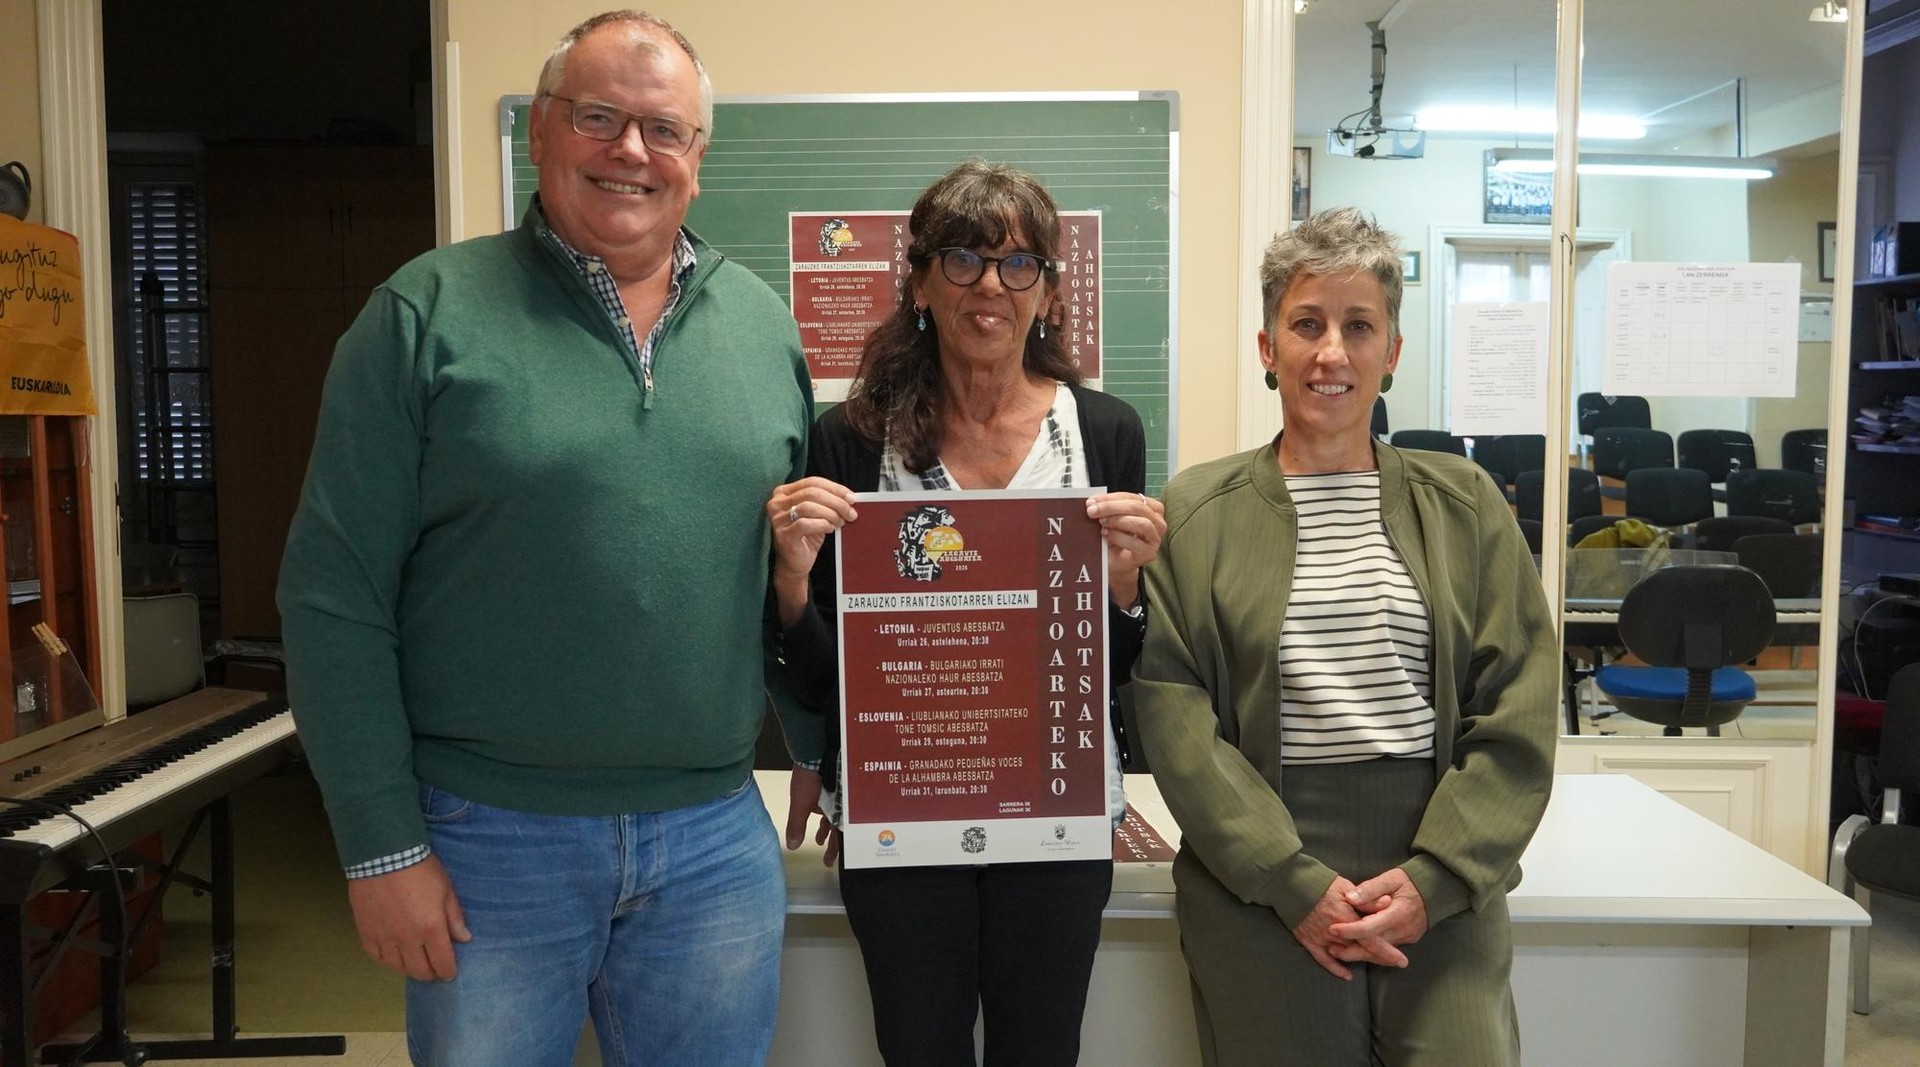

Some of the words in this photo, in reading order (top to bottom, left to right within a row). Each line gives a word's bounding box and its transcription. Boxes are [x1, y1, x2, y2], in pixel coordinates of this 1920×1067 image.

[0, 241, 58, 290] ugituz
[26, 270, 74, 326] dugu
[1071, 225, 1080, 368] NAZIOARTEKO
[1085, 250, 1094, 345] AHOTSAK
[848, 596, 897, 609] ZARAUZKO
[900, 594, 994, 608] FRANTZISKOTARREN
[997, 593, 1030, 606] ELIZAN
[879, 623, 915, 635] LETONIA
[922, 622, 961, 633] JUVENTUS
[963, 621, 1005, 632] ABESBATZA
[897, 637, 918, 647] Urriak
[1047, 517, 1067, 796] NAZIOARTEKO
[1075, 564, 1094, 749] AHOTSAK
[881, 661, 923, 672] BULGARIA
[930, 660, 977, 671] BULGARIAKO
[979, 658, 1004, 669] IRRATI
[885, 673, 936, 684] NAZIONALEKO
[939, 672, 959, 683] HAUR
[961, 671, 1003, 682] ABESBATZA
[902, 687, 923, 697] Urriak
[858, 711, 904, 722] ESLOVENIA
[911, 709, 959, 721] LIUBLIANAKO
[962, 708, 1028, 719] UNIBERTSITATEKO
[895, 724, 914, 734] TONE
[917, 723, 945, 734] TOMSIC
[947, 722, 989, 733] ABESBATZA
[901, 738, 922, 747] Urriak
[864, 761, 902, 771] ESPAINIA
[909, 759, 954, 770] GRANADAKO
[956, 756, 996, 768] PEQUEÑAS
[998, 757, 1023, 768] VOCES
[889, 774, 899, 784] DE
[901, 773, 911, 783] LA
[912, 772, 951, 783] ALHAMBRA
[952, 771, 994, 782] ABESBATZA
[901, 787, 921, 797] Urriak
